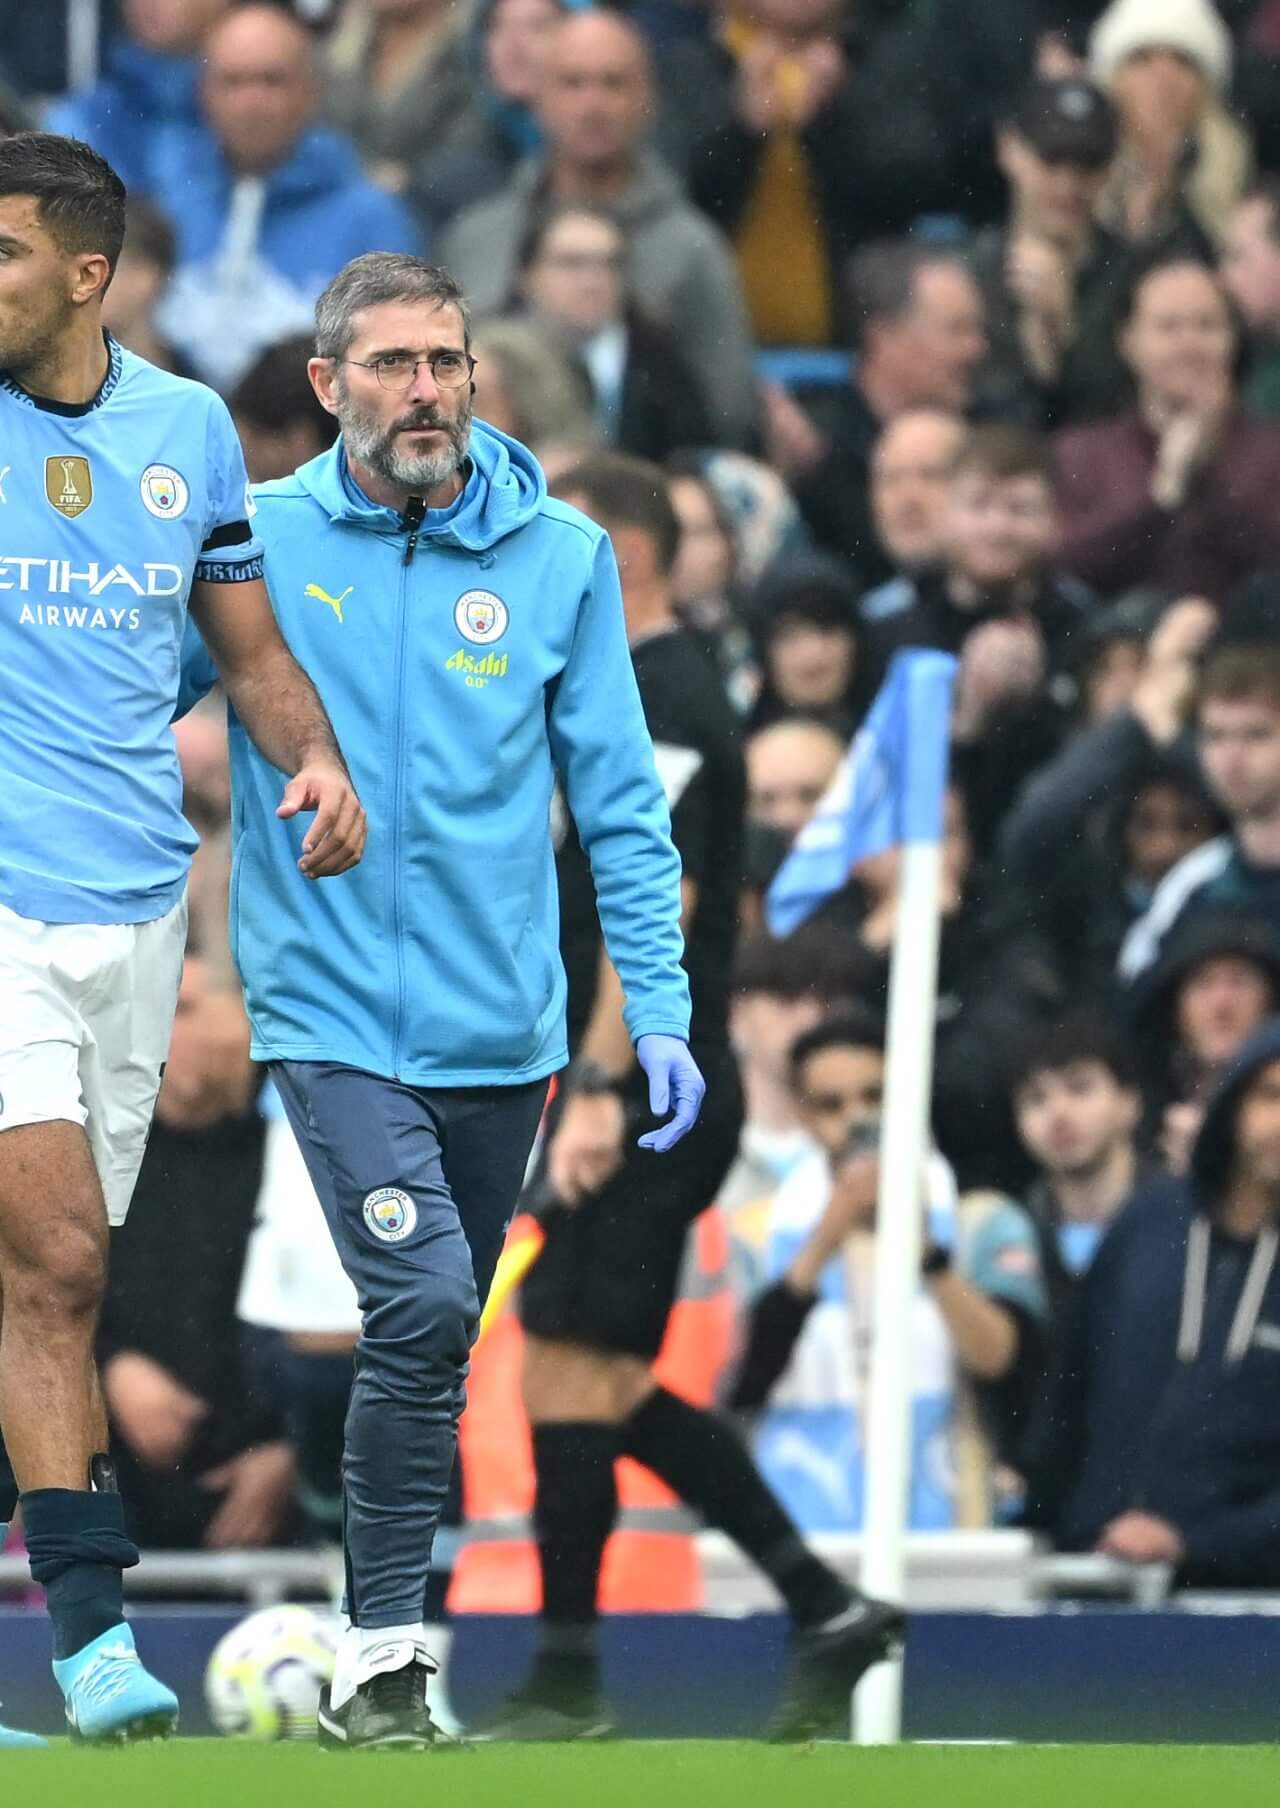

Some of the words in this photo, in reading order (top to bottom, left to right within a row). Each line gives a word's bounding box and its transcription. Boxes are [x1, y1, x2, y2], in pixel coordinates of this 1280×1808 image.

[59, 494, 82, 504] FIFA
[19, 604, 141, 630] AIRWAYS
[445, 648, 508, 677] Asahi
[365, 1189, 407, 1213] MANCHESTER
[388, 1230, 405, 1241] CITY
